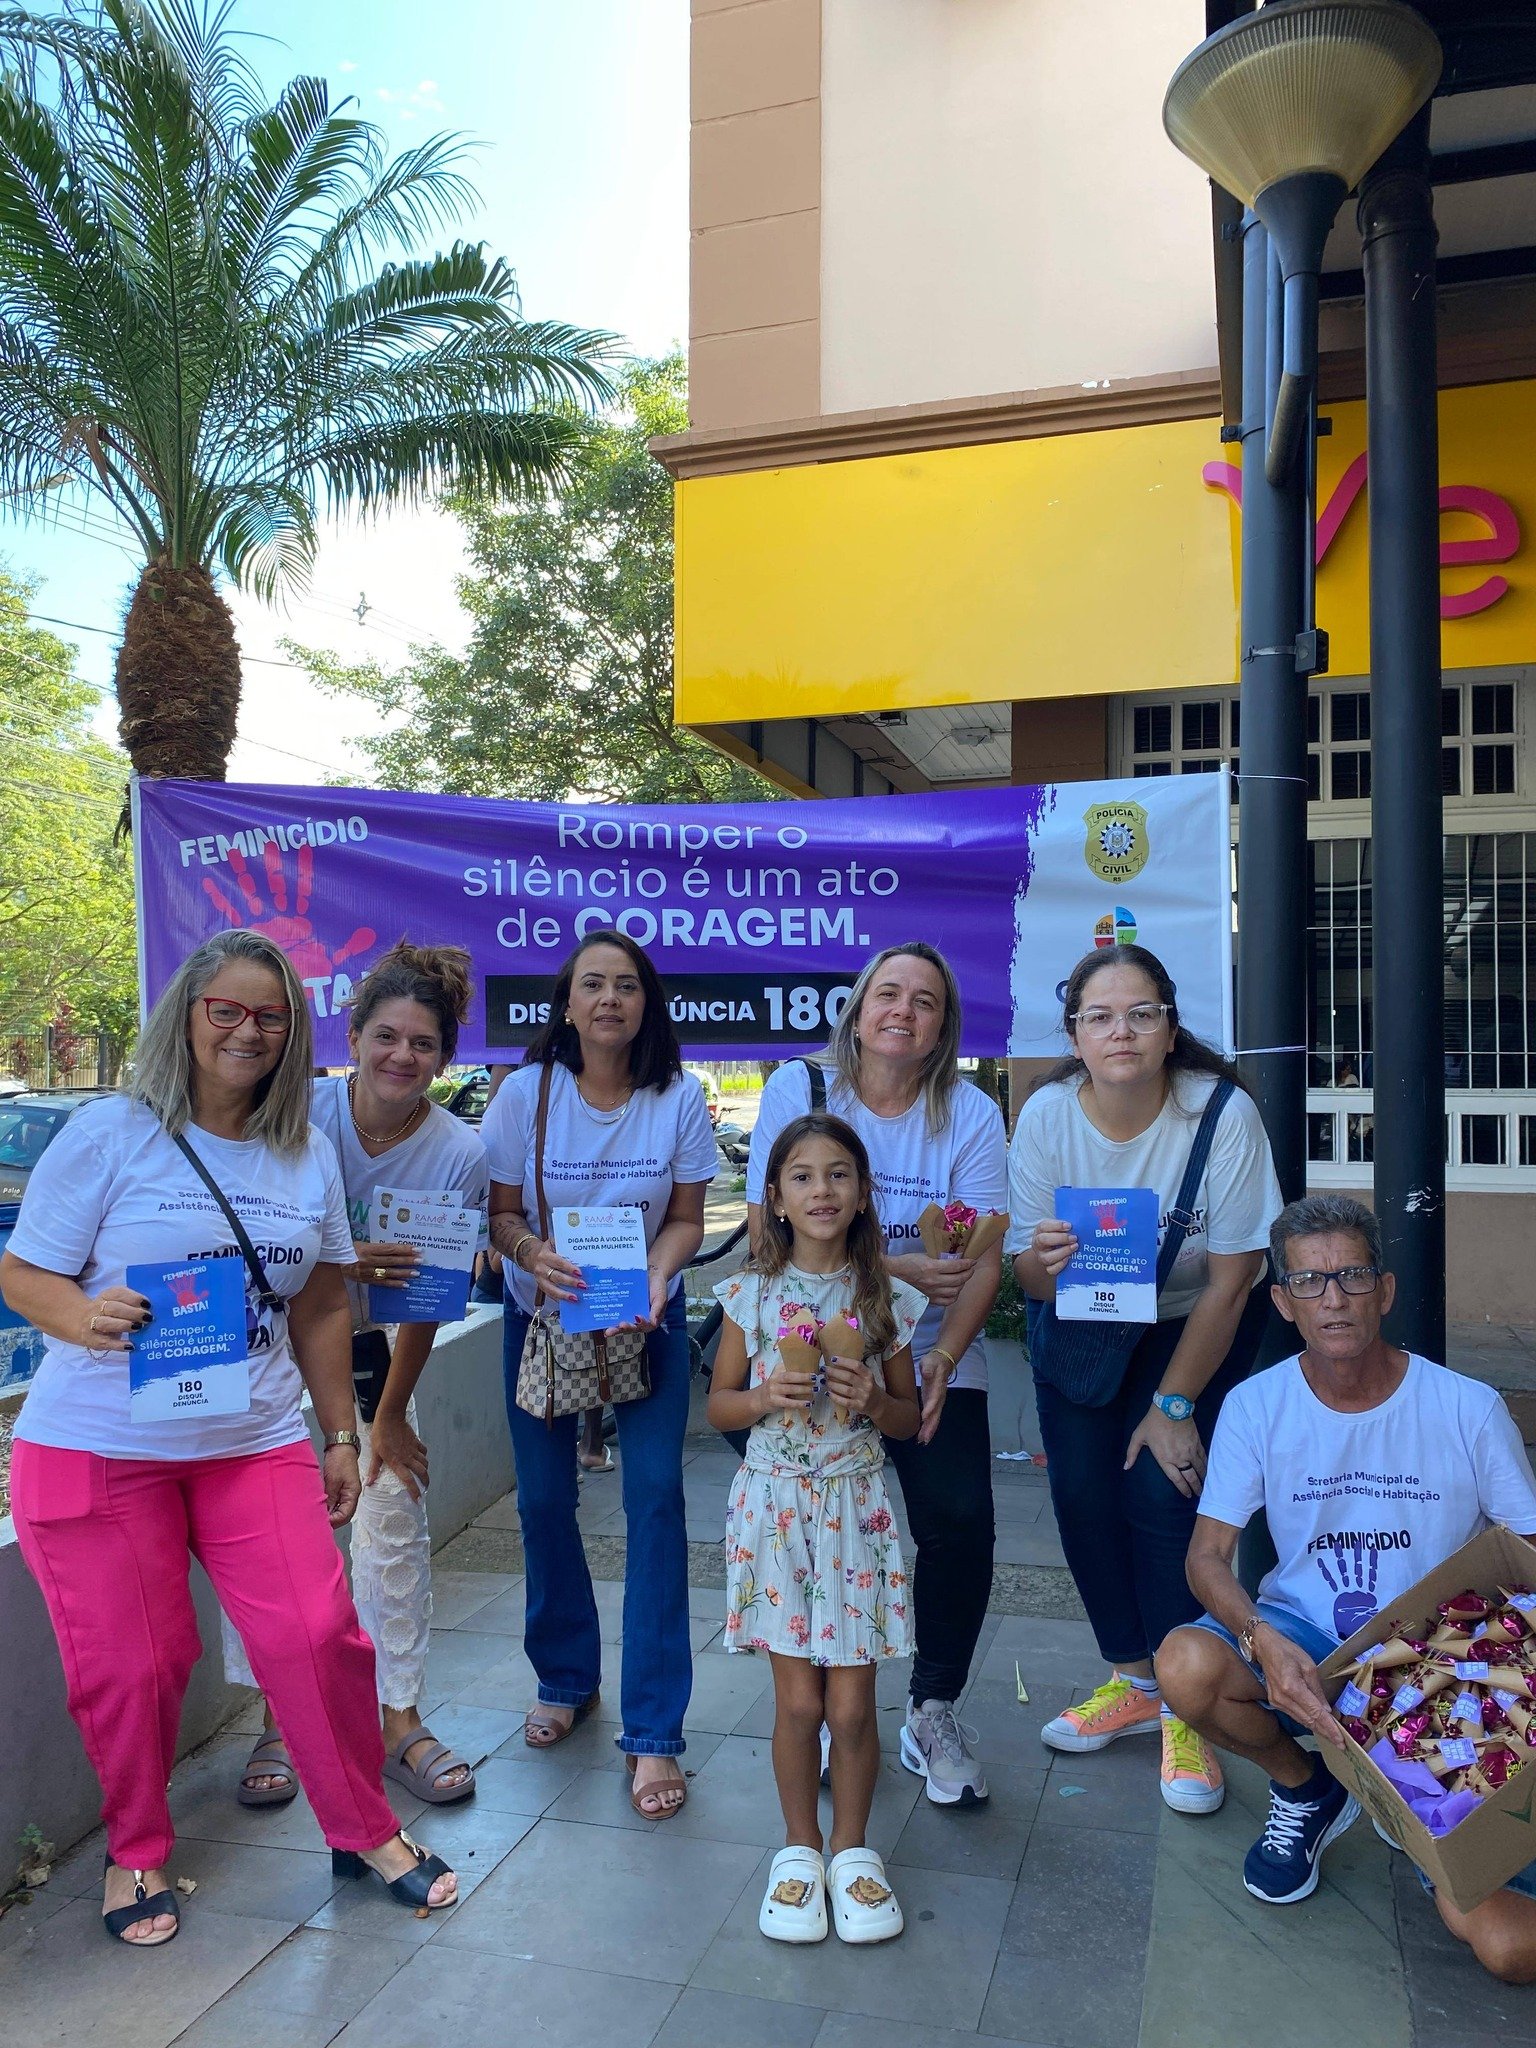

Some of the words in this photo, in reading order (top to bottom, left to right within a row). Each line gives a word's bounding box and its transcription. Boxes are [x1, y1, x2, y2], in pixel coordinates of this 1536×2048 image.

[1096, 806, 1134, 820] POLÍCIA
[179, 816, 369, 867] FEMINICÍDIO
[558, 813, 762, 858] Romper
[777, 826, 808, 849] o
[1102, 865, 1132, 874] CIVIL
[462, 855, 667, 898] silêncio
[682, 856, 711, 898] é
[727, 867, 801, 898] um
[817, 861, 899, 897] ato
[497, 907, 561, 948] de
[574, 906, 870, 947] CORAGEM.
[509, 1003, 551, 1024] DIS
[551, 1160, 599, 1169] Secretaria
[600, 1158, 644, 1168] Municipal
[646, 1157, 658, 1165] de
[543, 1171, 589, 1181] ssistência
[592, 1171, 619, 1180] Social
[627, 1168, 669, 1179] Habitação
[874, 1171, 920, 1185] Municipal
[920, 1178, 931, 1186] de
[900, 1188, 947, 1201] Habitação
[234, 1208, 261, 1217] ocial
[273, 1209, 321, 1224] Habitação
[393, 1232, 410, 1240] DIGA
[433, 1237, 469, 1245] VIOLÊNCIA
[1095, 1227, 1127, 1238] BASTA!
[397, 1240, 426, 1248] CONTRA
[427, 1243, 463, 1252] MULHERES.
[1083, 1244, 1122, 1255] Romper
[1105, 1253, 1112, 1263] é
[1113, 1256, 1129, 1264] um
[1130, 1257, 1148, 1266] ato
[162, 1265, 207, 1282] FEMINICÍDIO
[1071, 1261, 1084, 1269] de
[1085, 1261, 1142, 1274] CORAGEM.
[1094, 1291, 1116, 1302] 180
[172, 1300, 209, 1318] BASTA!
[1088, 1306, 1120, 1314] DENÚNCIA
[1093, 1301, 1115, 1309] DISQUE
[160, 1325, 206, 1338] Romper
[140, 1337, 185, 1351] silêncio
[187, 1335, 195, 1345] é
[197, 1335, 215, 1344] um
[217, 1332, 236, 1342] ato
[147, 1350, 162, 1360] de
[164, 1343, 231, 1359] CORAGEM.
[178, 1380, 203, 1393] 180
[173, 1398, 209, 1408] DENÚNCIA
[178, 1392, 204, 1401] DISQUE
[1354, 1471, 1403, 1486] Municipal
[1405, 1475, 1420, 1486] de
[1344, 1485, 1374, 1497] Social
[1374, 1490, 1381, 1498] e
[1382, 1489, 1441, 1504] Habitação
[1307, 1528, 1412, 1554] FEMINICÍDIO
